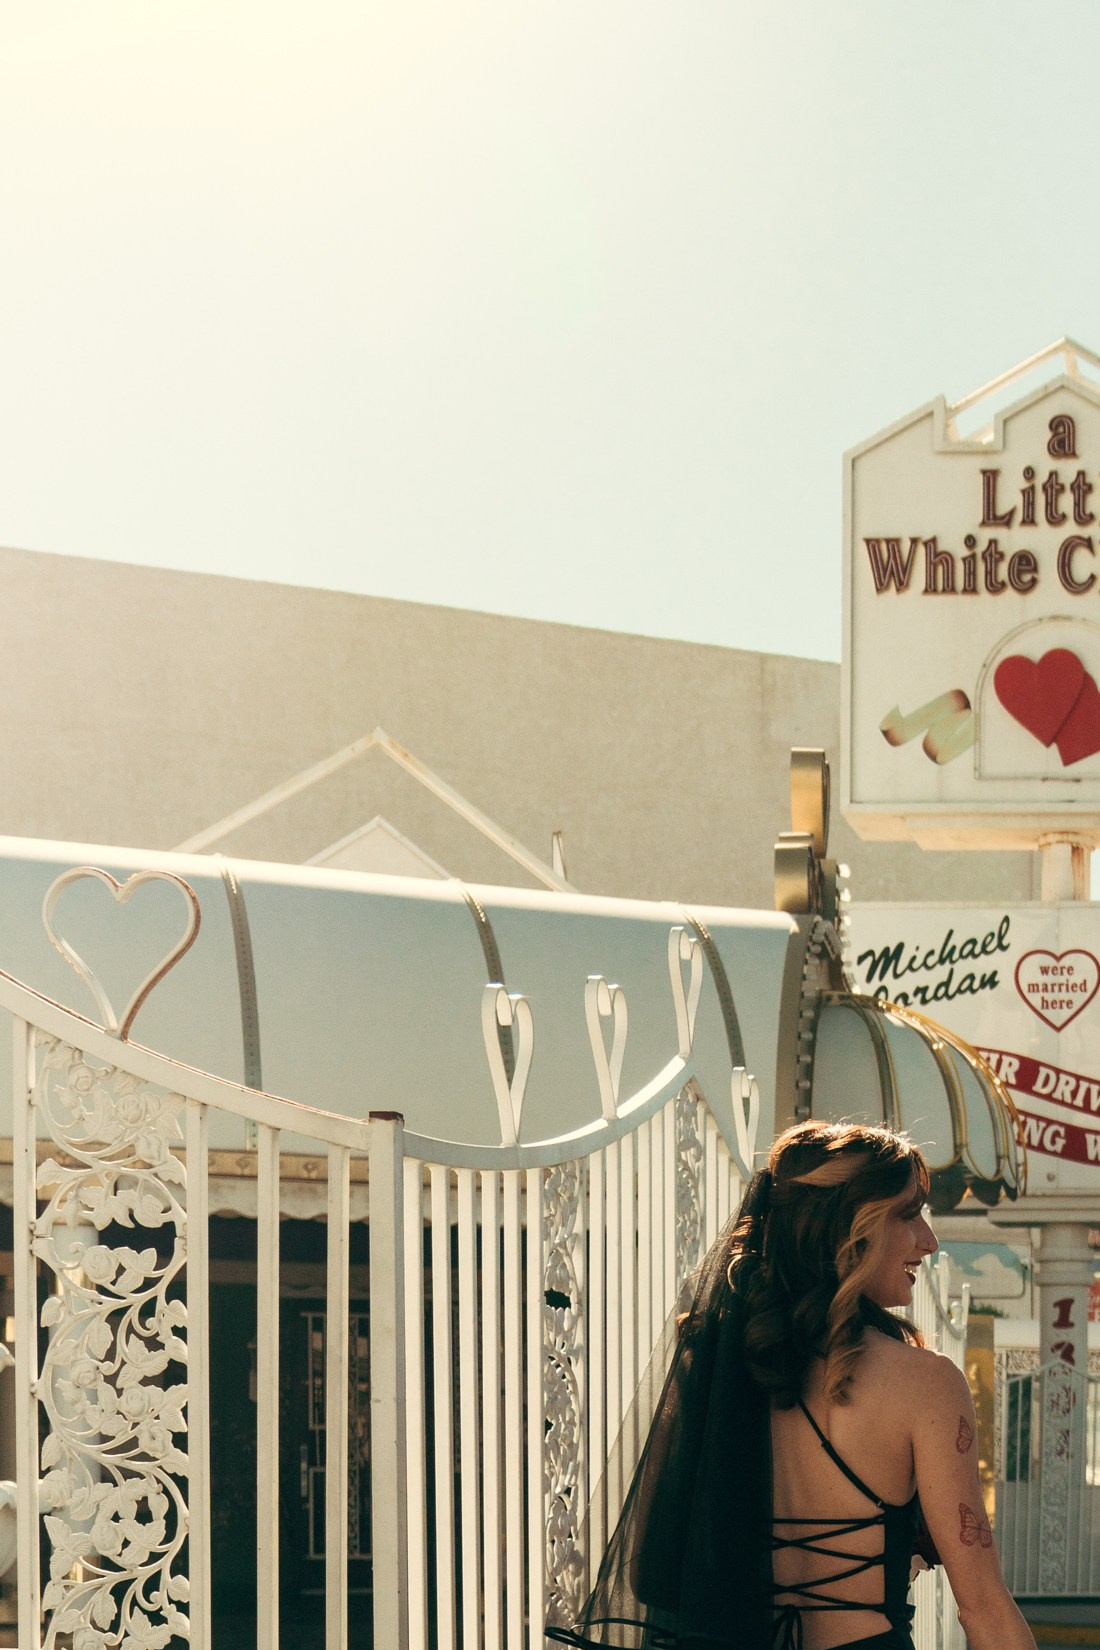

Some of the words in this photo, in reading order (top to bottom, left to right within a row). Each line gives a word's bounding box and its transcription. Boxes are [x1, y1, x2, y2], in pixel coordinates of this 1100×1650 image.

[1047, 414, 1079, 459] a
[864, 534, 1039, 596] White
[857, 915, 1011, 984] Michael
[1039, 964, 1074, 976] were
[1027, 979, 1088, 993] married
[1041, 996, 1074, 1010] here
